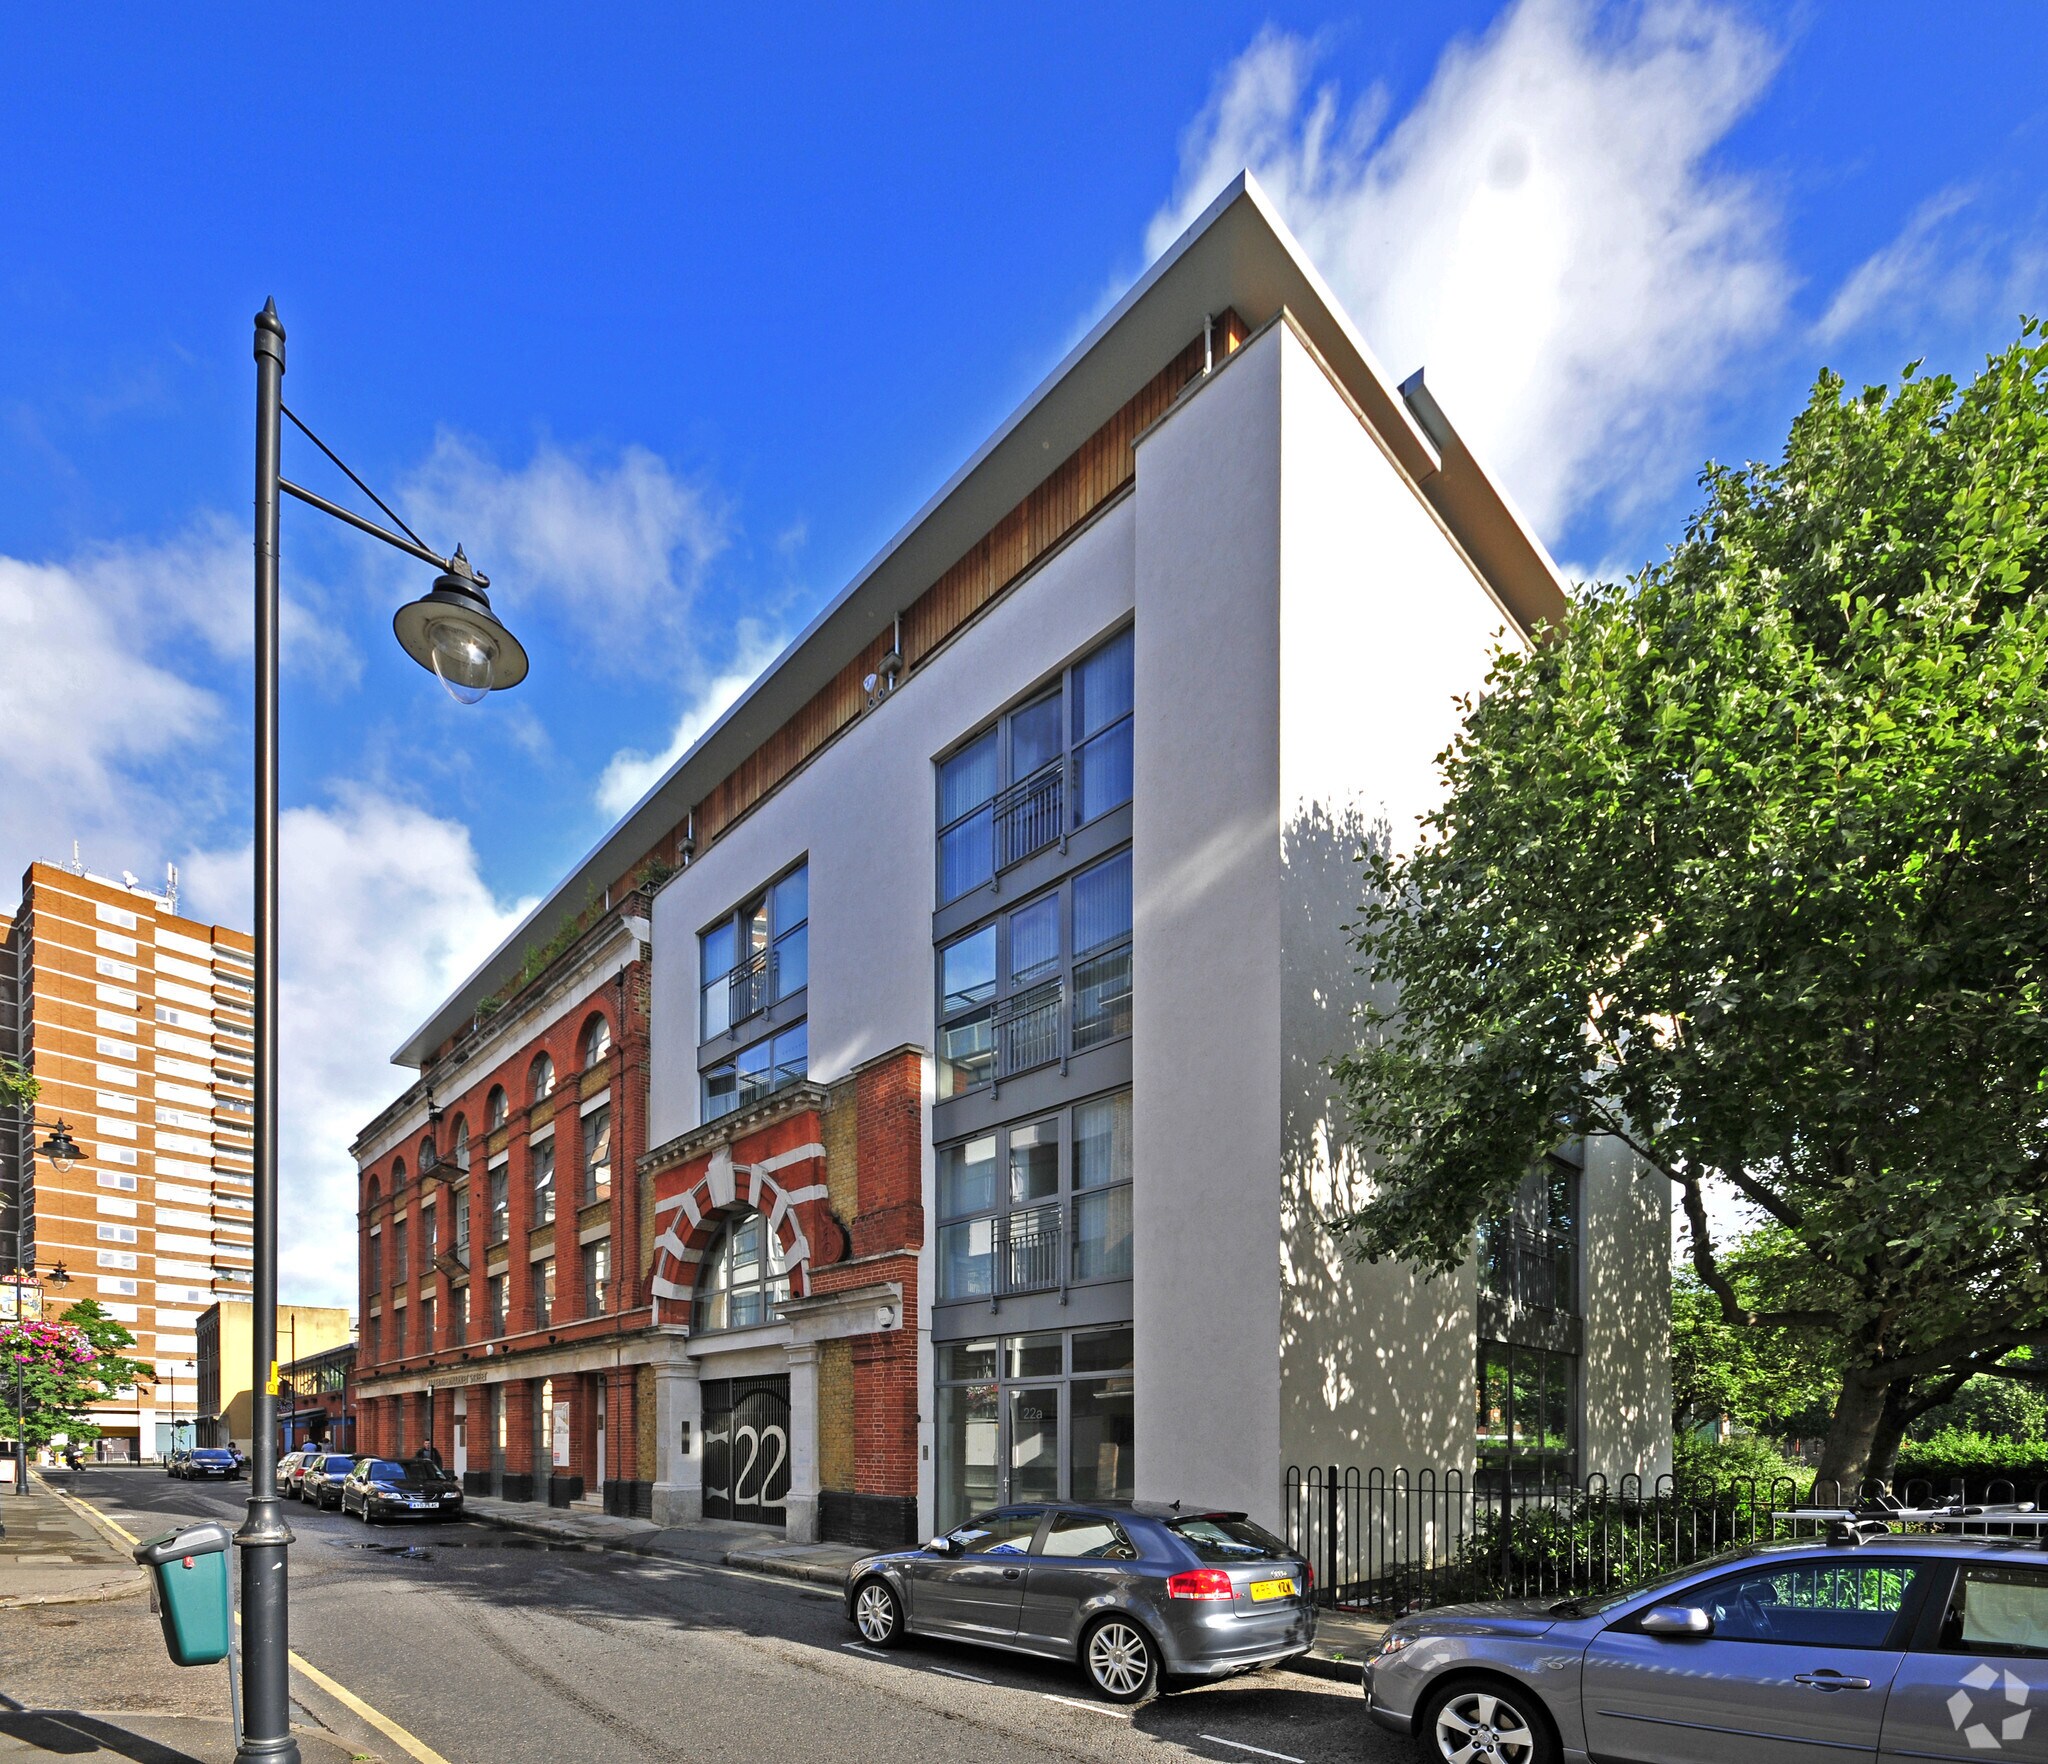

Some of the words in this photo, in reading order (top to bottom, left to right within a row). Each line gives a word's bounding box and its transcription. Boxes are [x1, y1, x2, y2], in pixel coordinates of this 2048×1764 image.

[470, 1371, 488, 1383] STREET
[1023, 1407, 1043, 1420] 22a
[735, 1424, 787, 1508] 22
